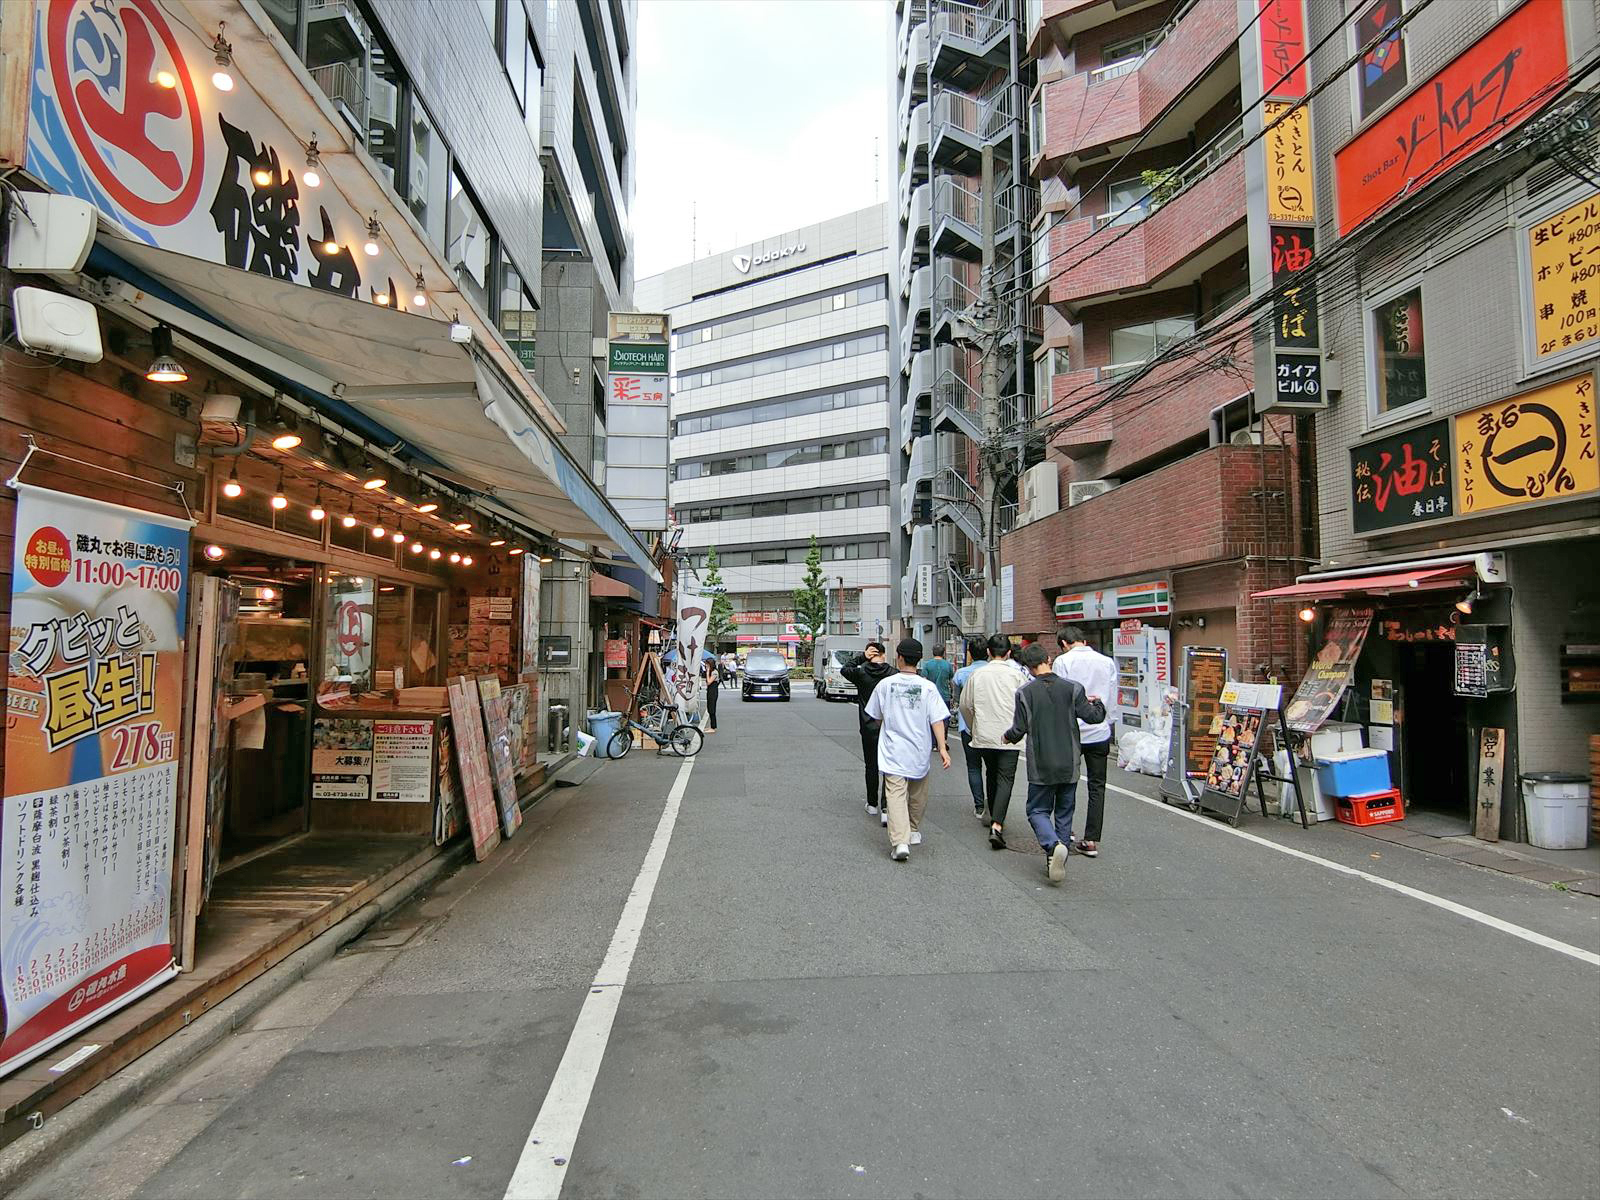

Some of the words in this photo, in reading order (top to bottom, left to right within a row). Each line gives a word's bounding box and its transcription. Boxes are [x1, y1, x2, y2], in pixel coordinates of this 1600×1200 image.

[1264, 103, 1281, 114] 2F
[1274, 119, 1286, 181] やきとり
[1289, 110, 1306, 173] やきとん
[1361, 166, 1381, 187] Shot
[1382, 155, 1400, 174] Bar
[1534, 203, 1599, 247] 生ビール
[753, 243, 806, 266] odakyu
[1537, 246, 1600, 282] ホッピー
[613, 350, 647, 362] BIOTECH
[648, 352, 665, 362] HAIR
[1541, 339, 1556, 355] 2F
[613, 377, 641, 400] 彩
[1277, 363, 1317, 378] ガイア
[1477, 404, 1520, 436] まる
[1576, 380, 1596, 461] やきとん
[1355, 460, 1372, 503] 秘伝
[1372, 443, 1428, 513] 油
[1428, 438, 1448, 488] そば
[1461, 440, 1474, 510] やきとり
[1411, 495, 1449, 517] 春日亭
[25, 553, 71, 573] 特別価格
[35, 539, 64, 556] お昼は
[19, 606, 141, 675] グビッと
[675, 606, 707, 701] つけ麺
[1117, 634, 1135, 646] KIRIN
[1154, 640, 1167, 681] KIRIN
[1311, 660, 1334, 670] World
[1481, 733, 1497, 819] 営業中
[48, 795, 59, 840] 緑茶割り
[61, 793, 71, 871] ウーロン茶割り
[15, 800, 28, 907] ソフトドリンク各種
